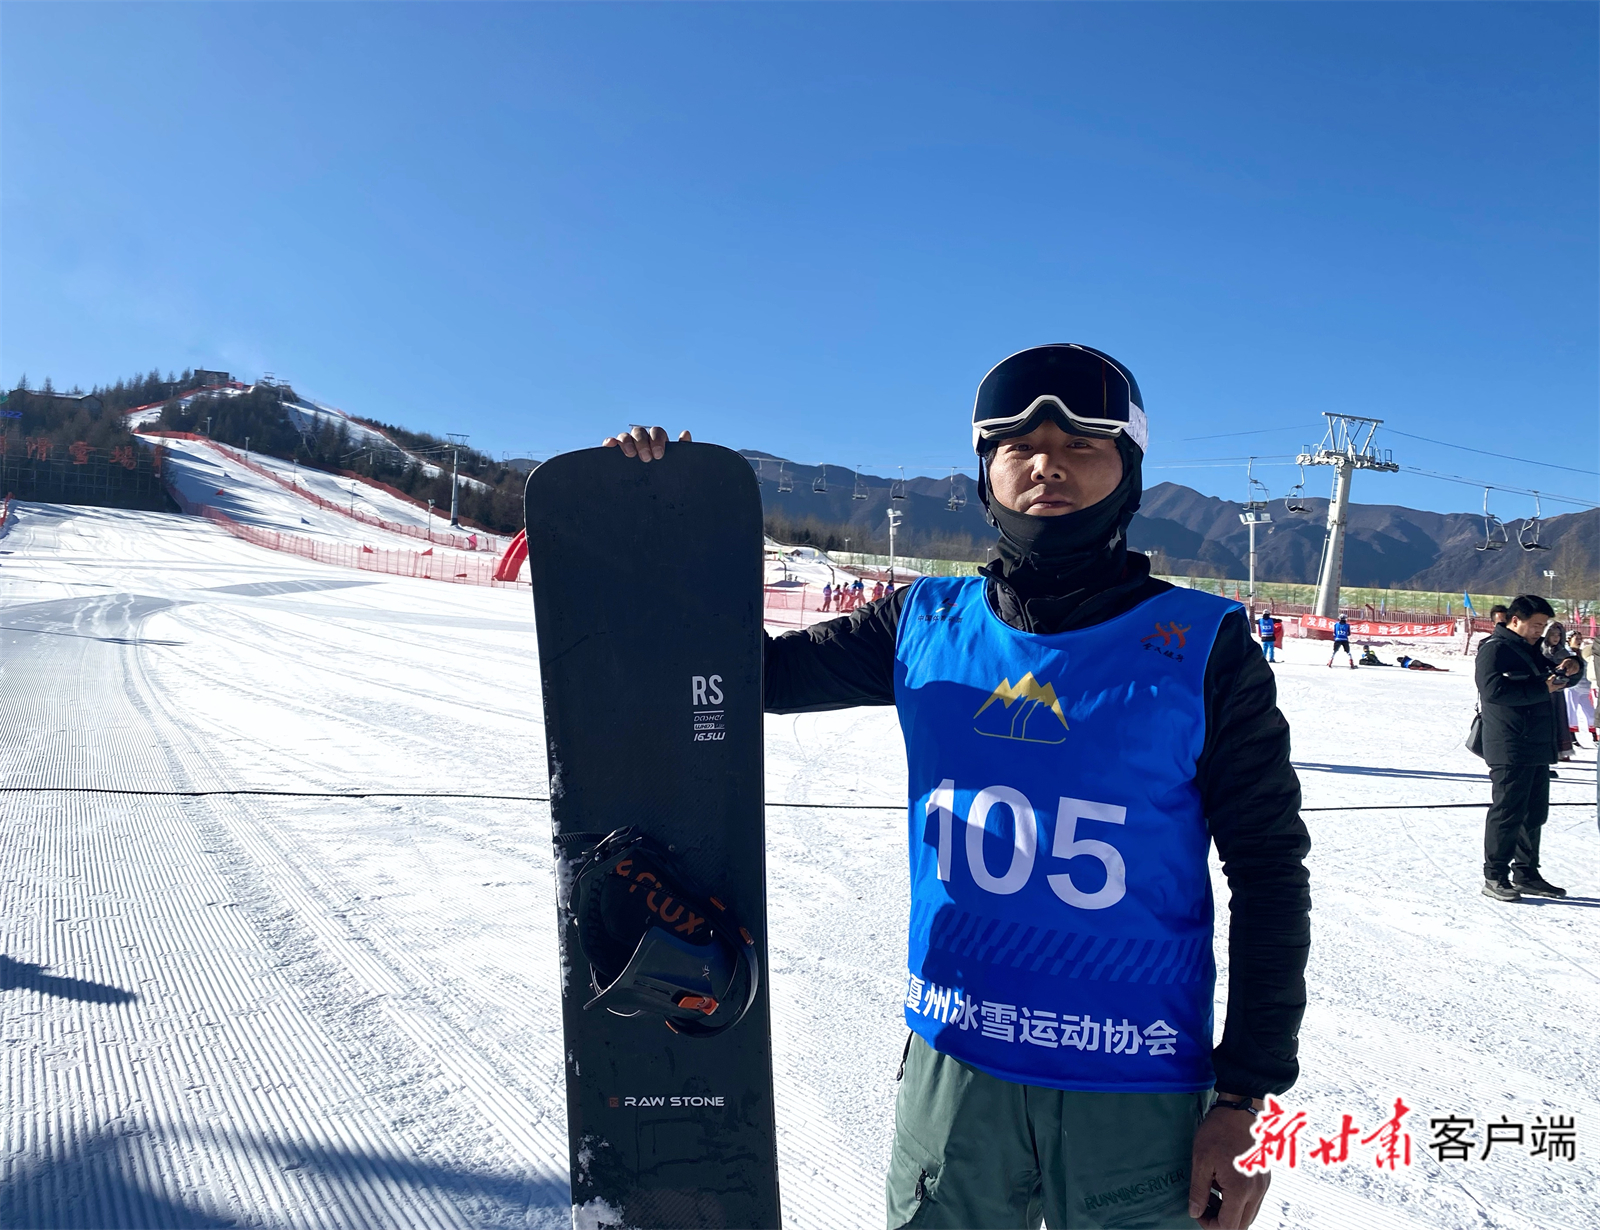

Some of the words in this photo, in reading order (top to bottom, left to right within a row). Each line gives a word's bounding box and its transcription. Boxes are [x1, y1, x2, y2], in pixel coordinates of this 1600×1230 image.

[1307, 617, 1369, 634] 发展体运动
[692, 674, 724, 706] RS
[925, 778, 1127, 910] 105
[624, 1096, 665, 1107] RAW
[670, 1096, 725, 1107] STONE
[1084, 1183, 1146, 1210] RUNNING
[1148, 1168, 1186, 1192] RIVER
